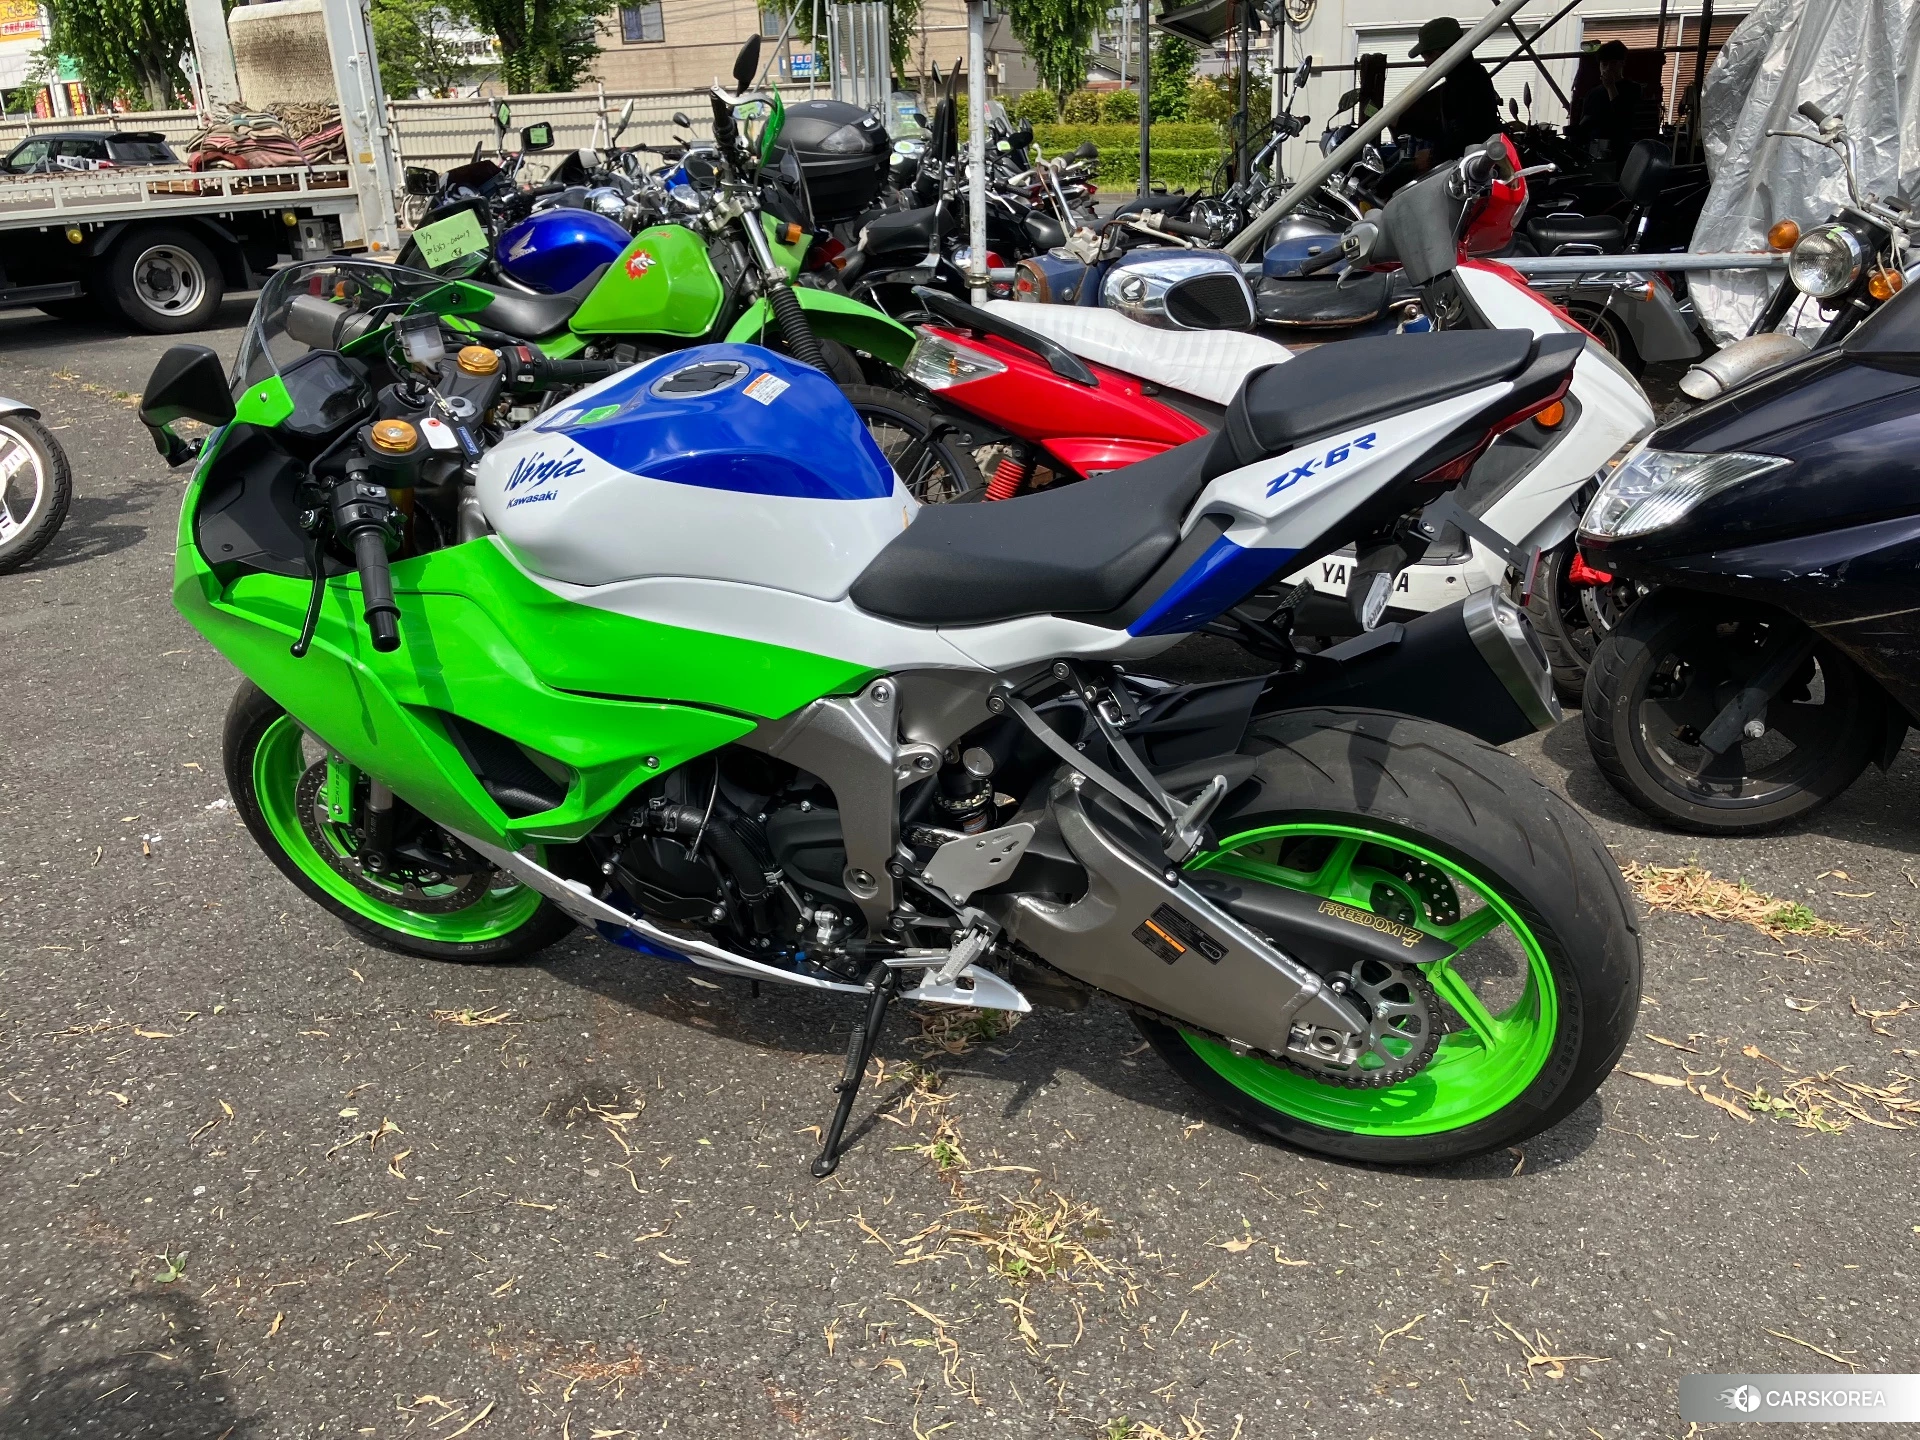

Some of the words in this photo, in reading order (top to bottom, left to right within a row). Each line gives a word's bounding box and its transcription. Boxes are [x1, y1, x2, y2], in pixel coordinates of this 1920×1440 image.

[504, 447, 586, 493] Ninja
[1266, 432, 1376, 499] ZX-6R
[506, 489, 559, 510] Kawasaki
[1322, 562, 1409, 593] YAA
